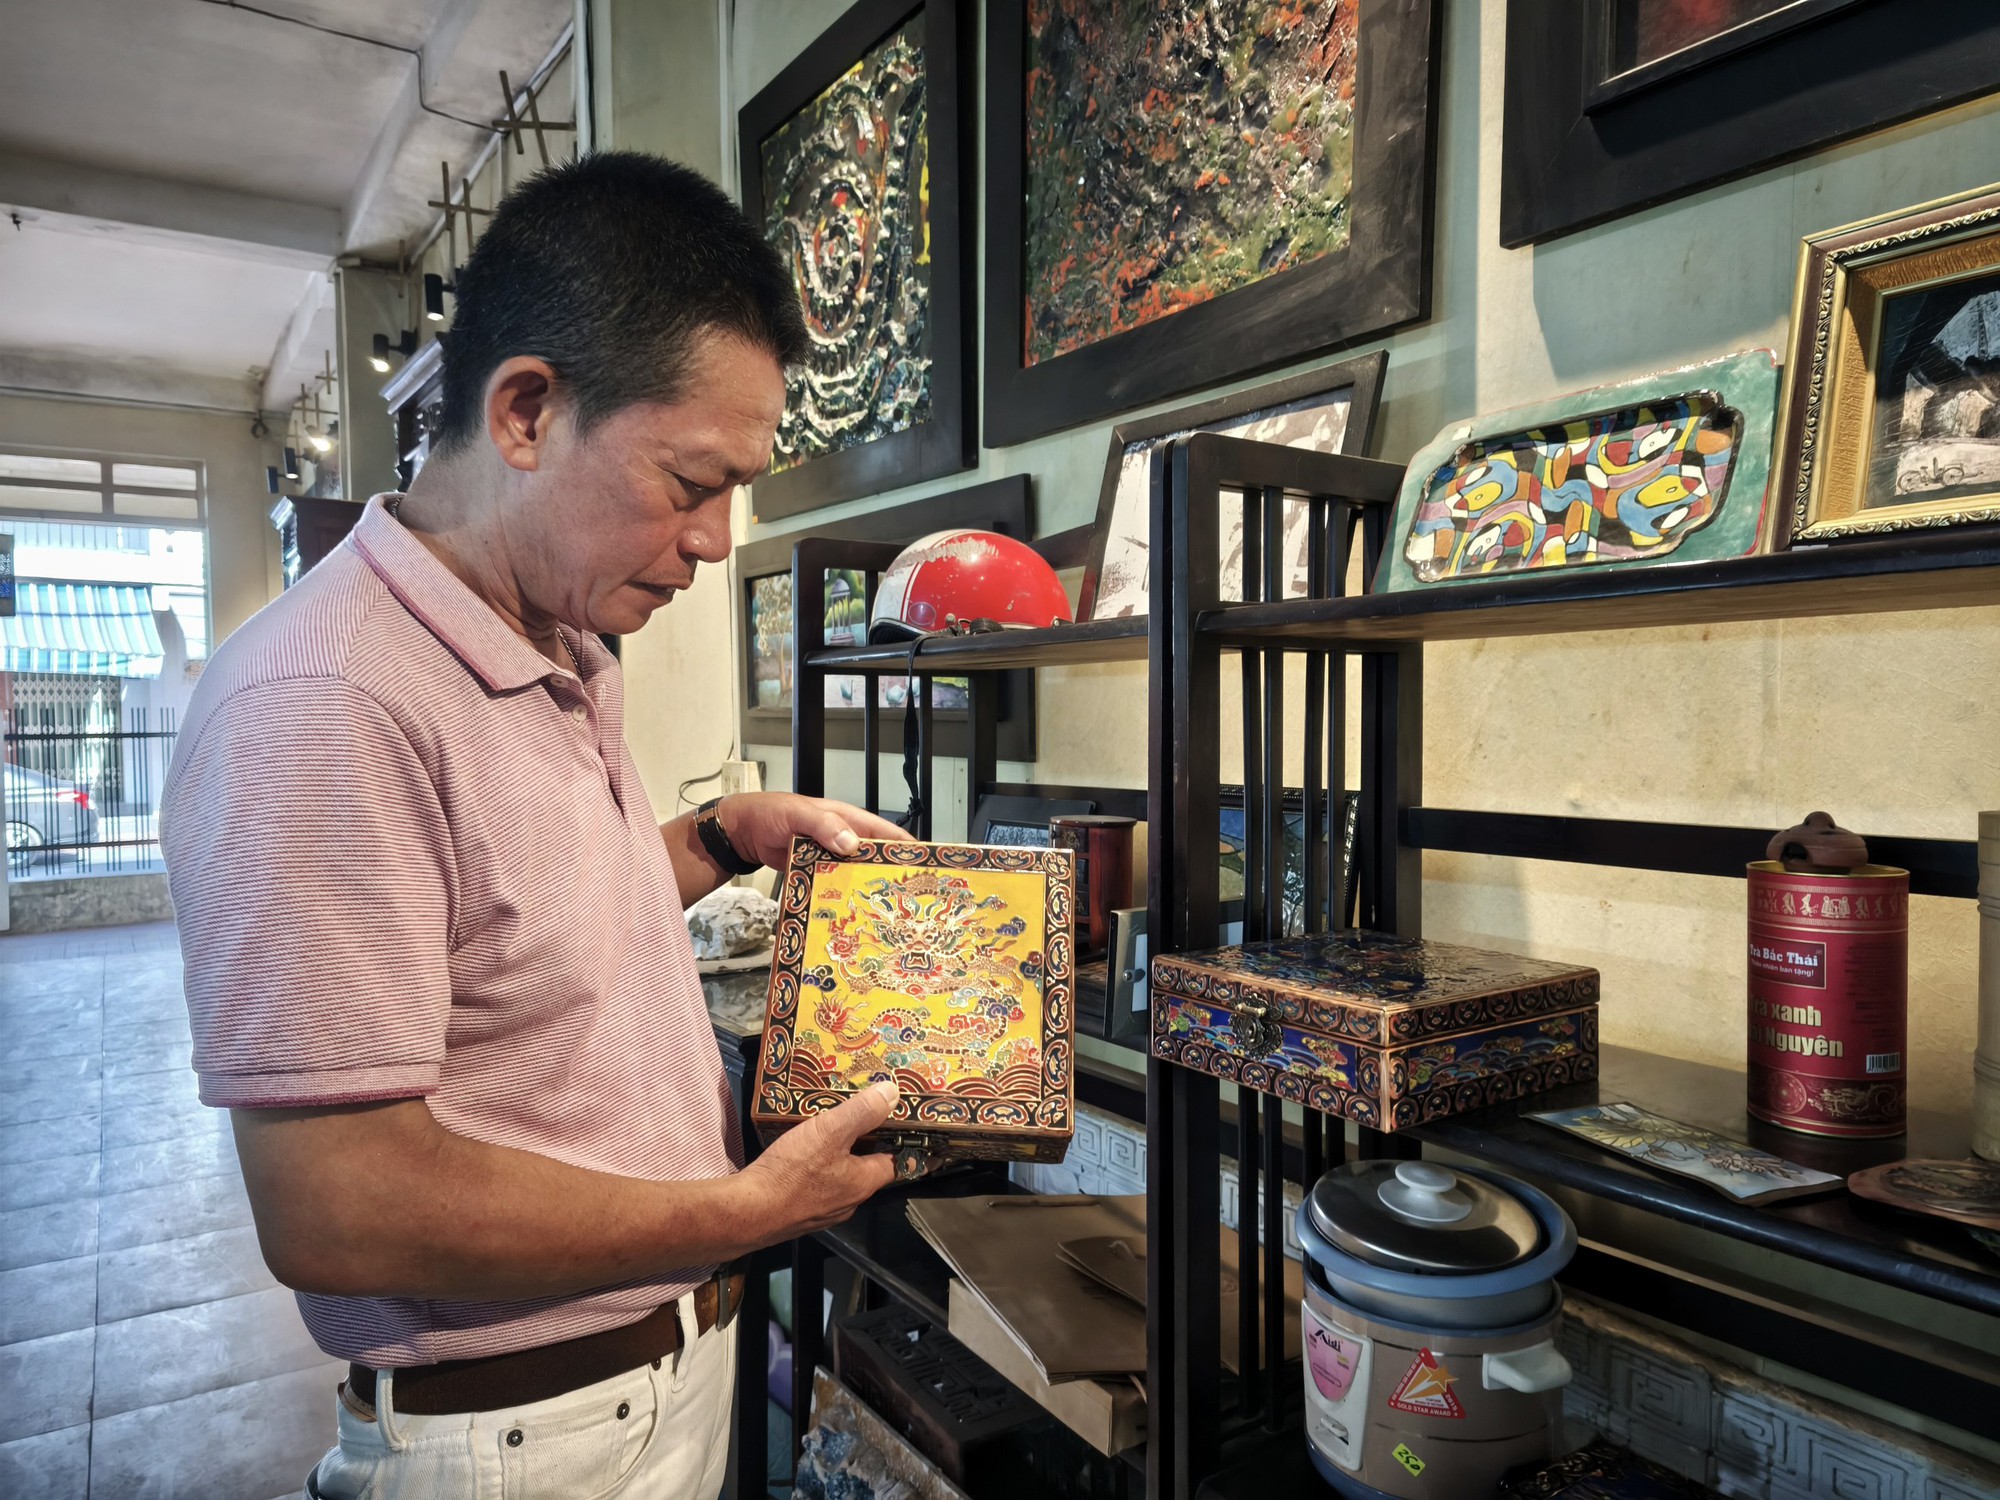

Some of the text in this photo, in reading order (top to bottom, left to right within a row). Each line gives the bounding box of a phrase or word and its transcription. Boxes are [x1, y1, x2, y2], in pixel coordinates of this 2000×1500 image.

[1763, 947, 1783, 962] Bắc
[1786, 951, 1818, 967] Thái
[1779, 966, 1793, 974] ban
[1771, 1003, 1822, 1027] xanh
[1765, 1025, 1844, 1058] Nguyên
[1396, 1402, 1413, 1411] GOLD
[1413, 1406, 1429, 1414] STAR
[1429, 1408, 1452, 1417] AWARD
[1397, 1449, 1421, 1471] 250
